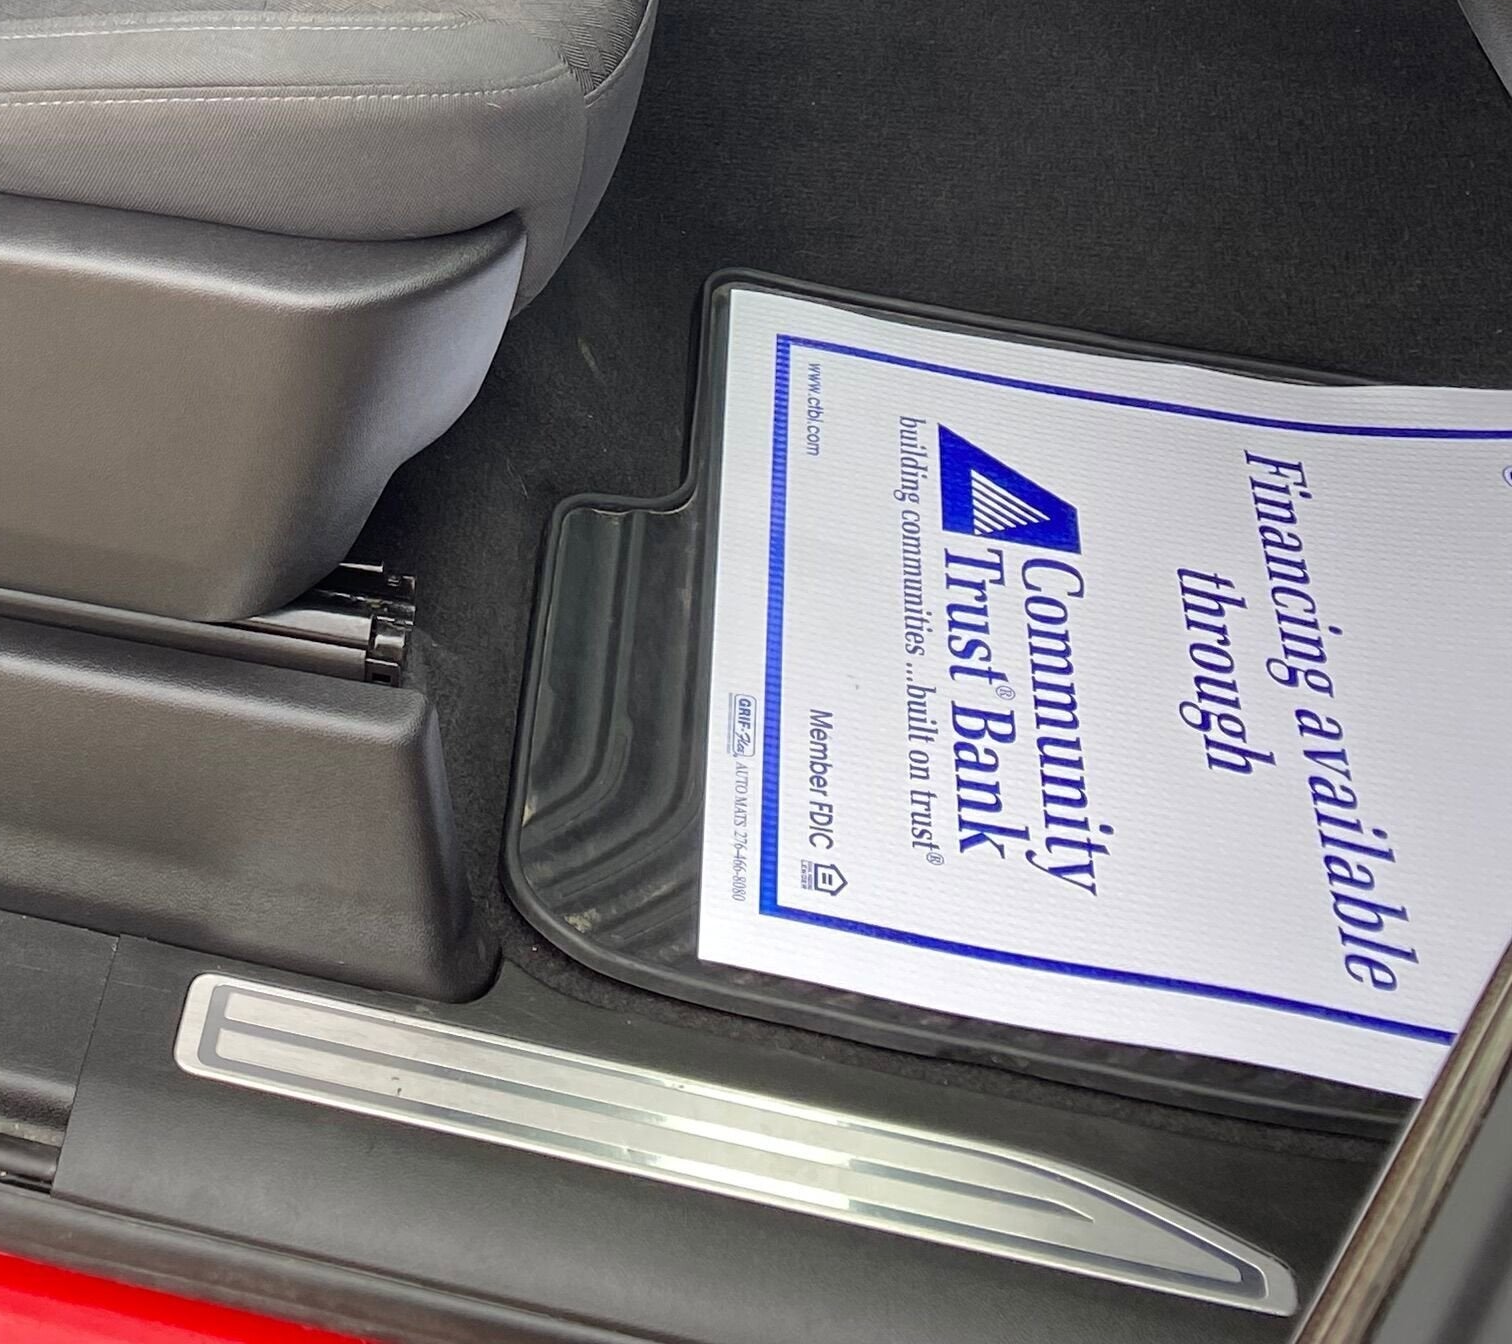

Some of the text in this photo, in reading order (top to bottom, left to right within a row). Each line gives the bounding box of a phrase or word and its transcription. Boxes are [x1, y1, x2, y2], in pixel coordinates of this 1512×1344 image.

[894, 416, 928, 504] building
[901, 510, 934, 655] communities
[1018, 557, 1114, 896] Community
[1176, 566, 1277, 775] through
[1244, 449, 1419, 991] Financing available
[733, 797, 748, 828] MATS
[734, 762, 748, 794] AUTO
[809, 709, 834, 849] Member FDIC
[909, 750, 930, 780] on
[951, 700, 1031, 859] Bank
[732, 830, 748, 901] 276-466-8080
